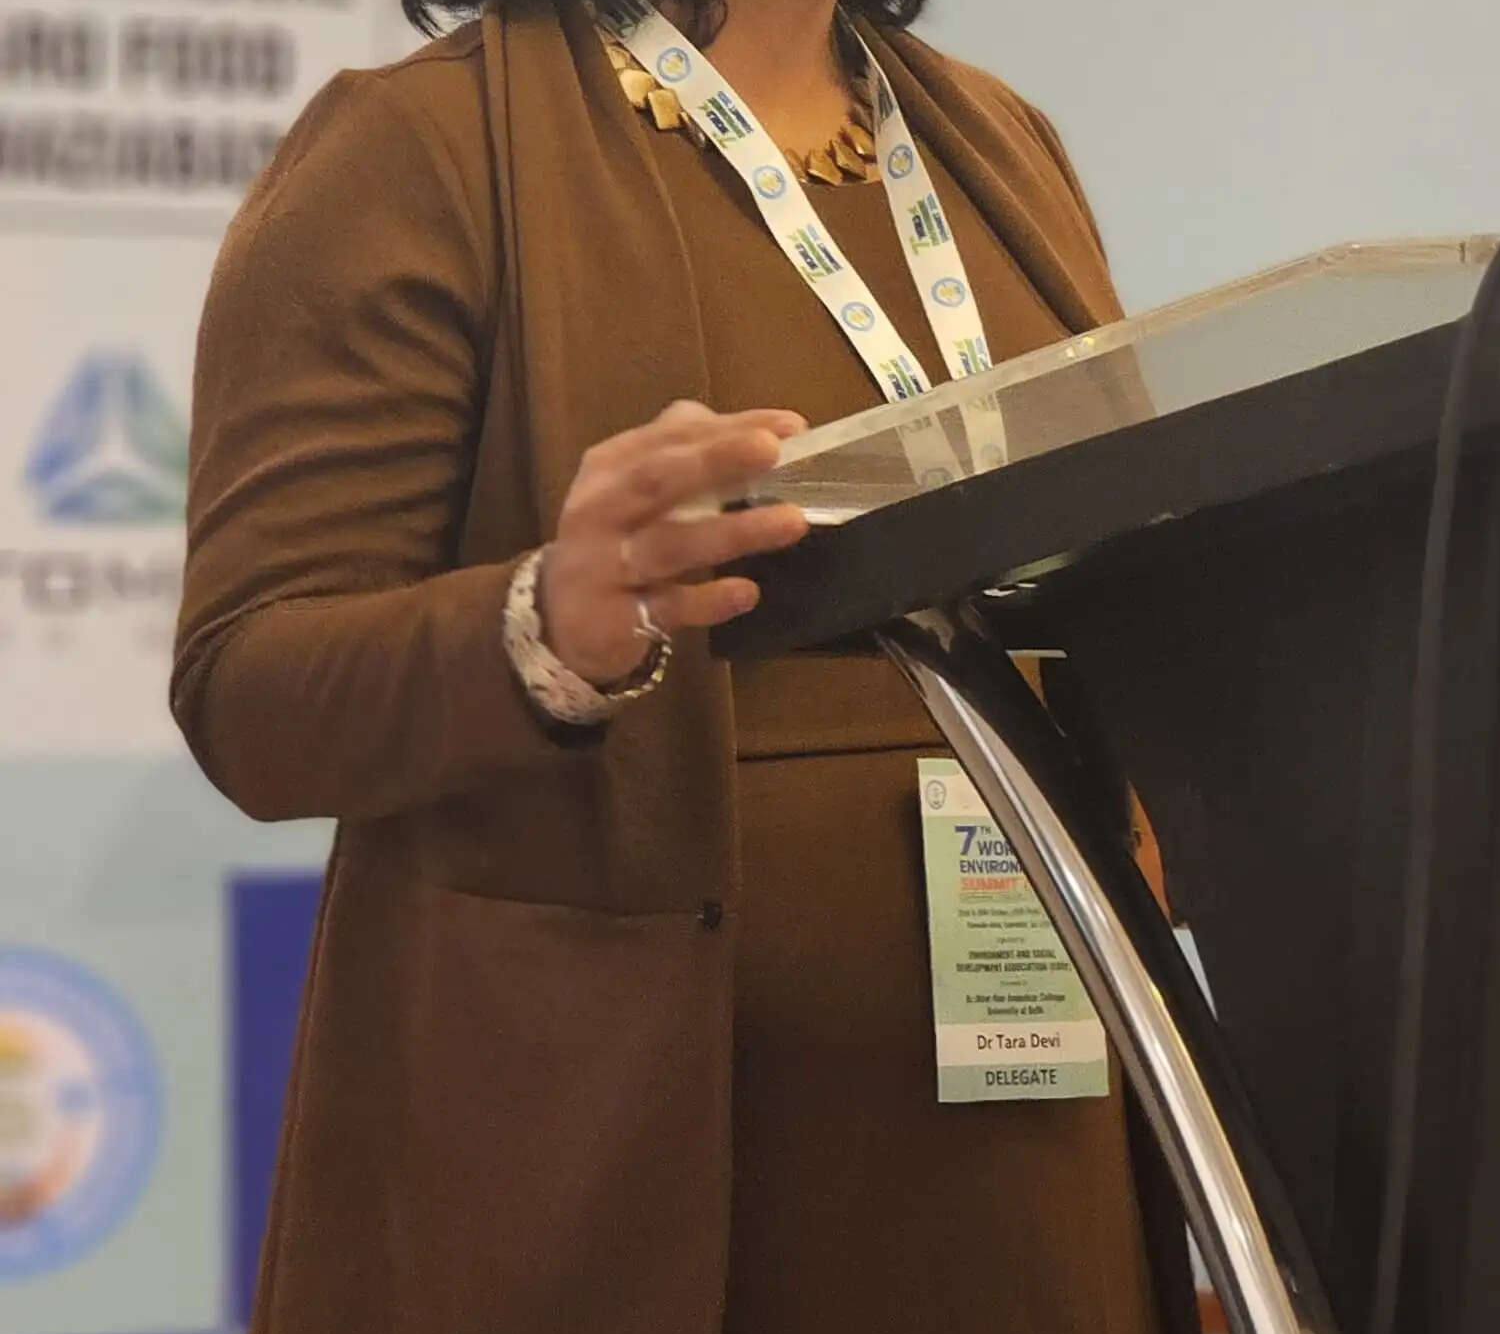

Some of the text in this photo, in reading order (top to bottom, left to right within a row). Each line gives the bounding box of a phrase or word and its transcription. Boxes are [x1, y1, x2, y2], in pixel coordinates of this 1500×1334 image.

[955, 826, 977, 855] 7
[977, 1032, 1061, 1050] Dr Tara Devi
[985, 1069, 1058, 1087] DELEGATE
